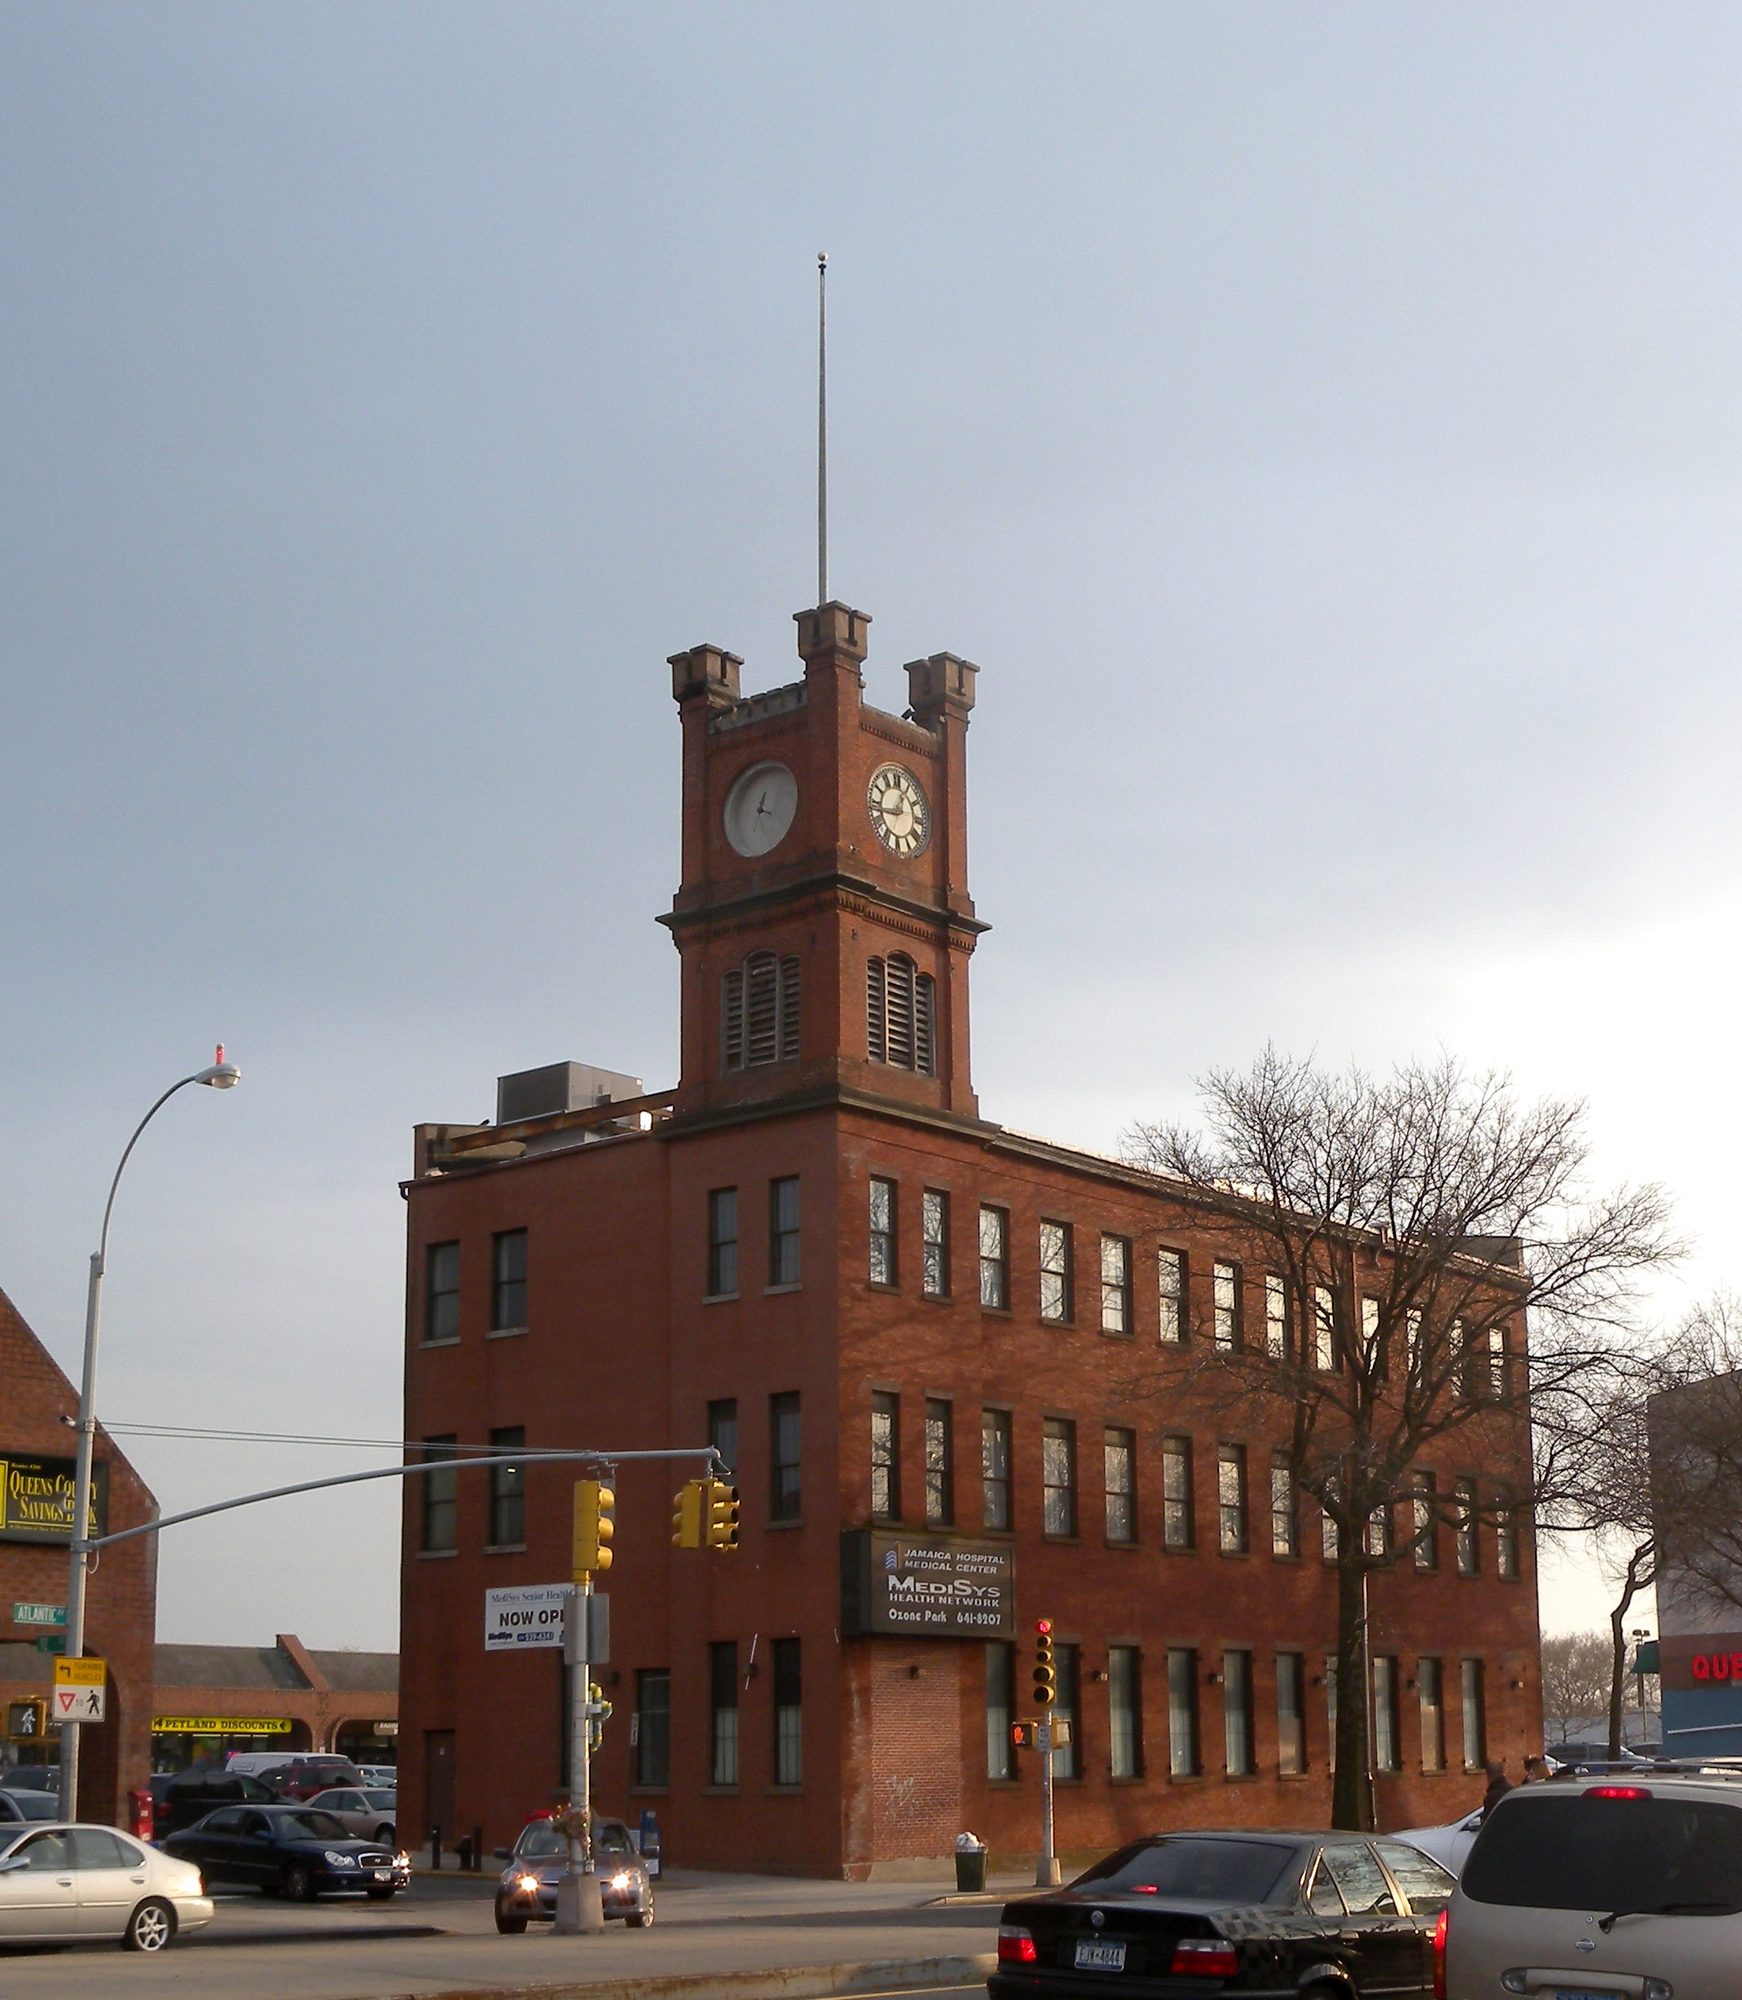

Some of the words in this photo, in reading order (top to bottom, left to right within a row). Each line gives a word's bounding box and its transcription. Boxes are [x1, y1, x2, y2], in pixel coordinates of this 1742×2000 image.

[10, 1470, 54, 1499] QUEENS
[55, 1474, 98, 1500] COY
[20, 1496, 64, 1521] SAVINGS
[904, 1549, 951, 1560] JAMAICA
[956, 1553, 1005, 1565] HOSPITAL
[904, 1560, 952, 1571] MEDICAL
[956, 1564, 997, 1574] CENTER
[889, 1593, 935, 1604] HEALTH
[939, 1596, 999, 1607] NETWORK
[18, 1606, 56, 1622] ATLANTIC
[500, 1610, 534, 1627] NOW
[888, 1608, 921, 1621] Ozone
[924, 1611, 947, 1623] Park
[165, 1719, 216, 1729] PETLAND
[221, 1720, 278, 1730] DISCOUNTS
